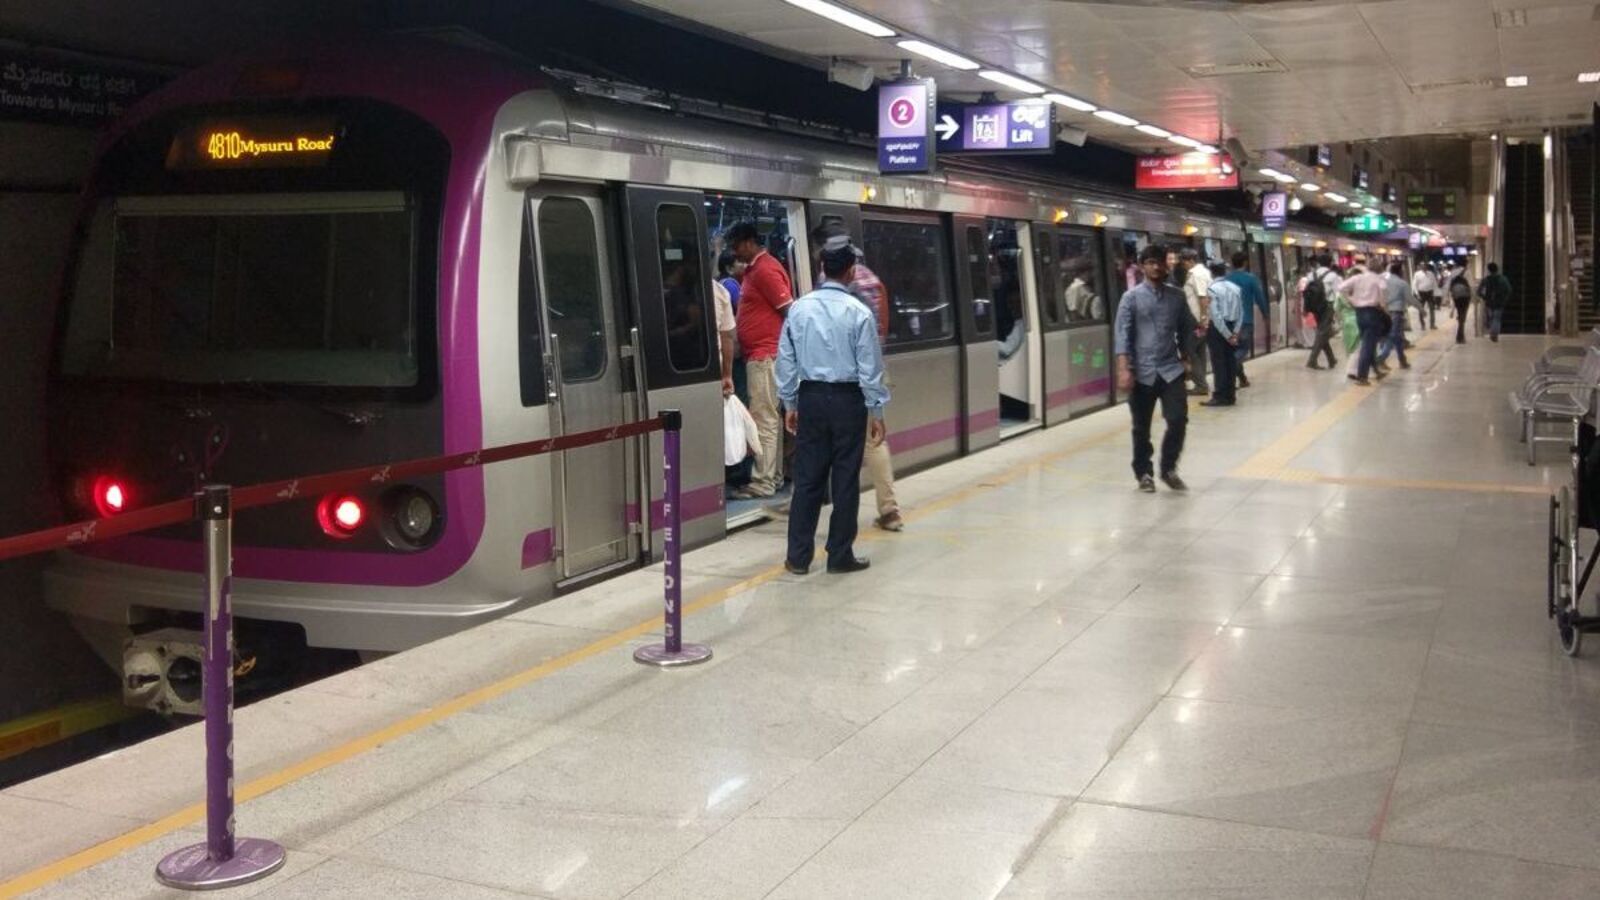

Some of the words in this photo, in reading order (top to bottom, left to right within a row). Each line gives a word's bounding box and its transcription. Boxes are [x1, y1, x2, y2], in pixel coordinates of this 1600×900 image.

[0, 90, 55, 110] Towards
[58, 96, 105, 115] Mysuru
[897, 104, 908, 122] 2
[208, 132, 241, 159] 4810
[241, 139, 294, 156] Mysuru
[1012, 128, 1034, 143] Lift
